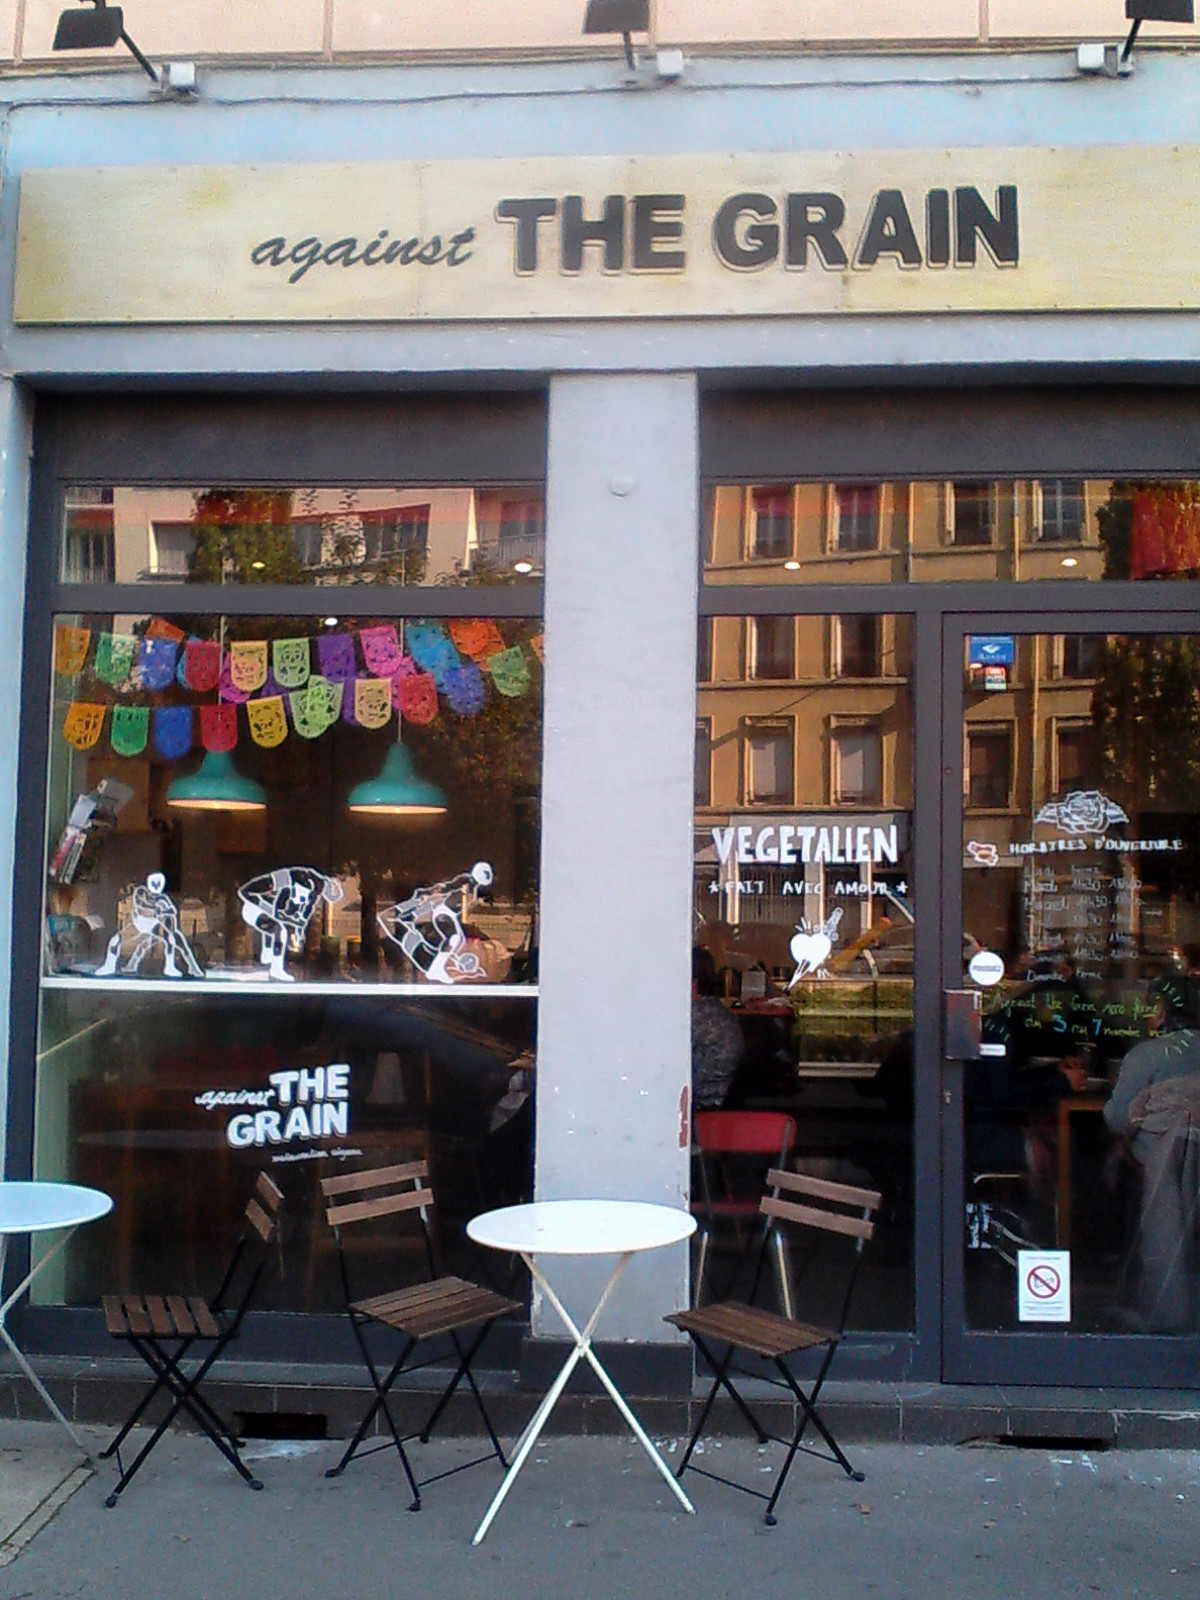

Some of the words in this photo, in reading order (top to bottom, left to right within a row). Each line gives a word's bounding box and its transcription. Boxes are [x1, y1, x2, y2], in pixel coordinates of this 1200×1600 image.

[251, 226, 475, 285] against
[494, 193, 688, 277] THE
[711, 184, 1021, 275] GRAIN
[711, 825, 899, 865] VEGETALIEN
[724, 880, 765, 895] FAIT
[782, 880, 823, 896] AVEC
[834, 880, 891, 896] AMOUR
[194, 1088, 276, 1112] against
[269, 1063, 351, 1107] THE
[226, 1101, 349, 1149] GRAIN
